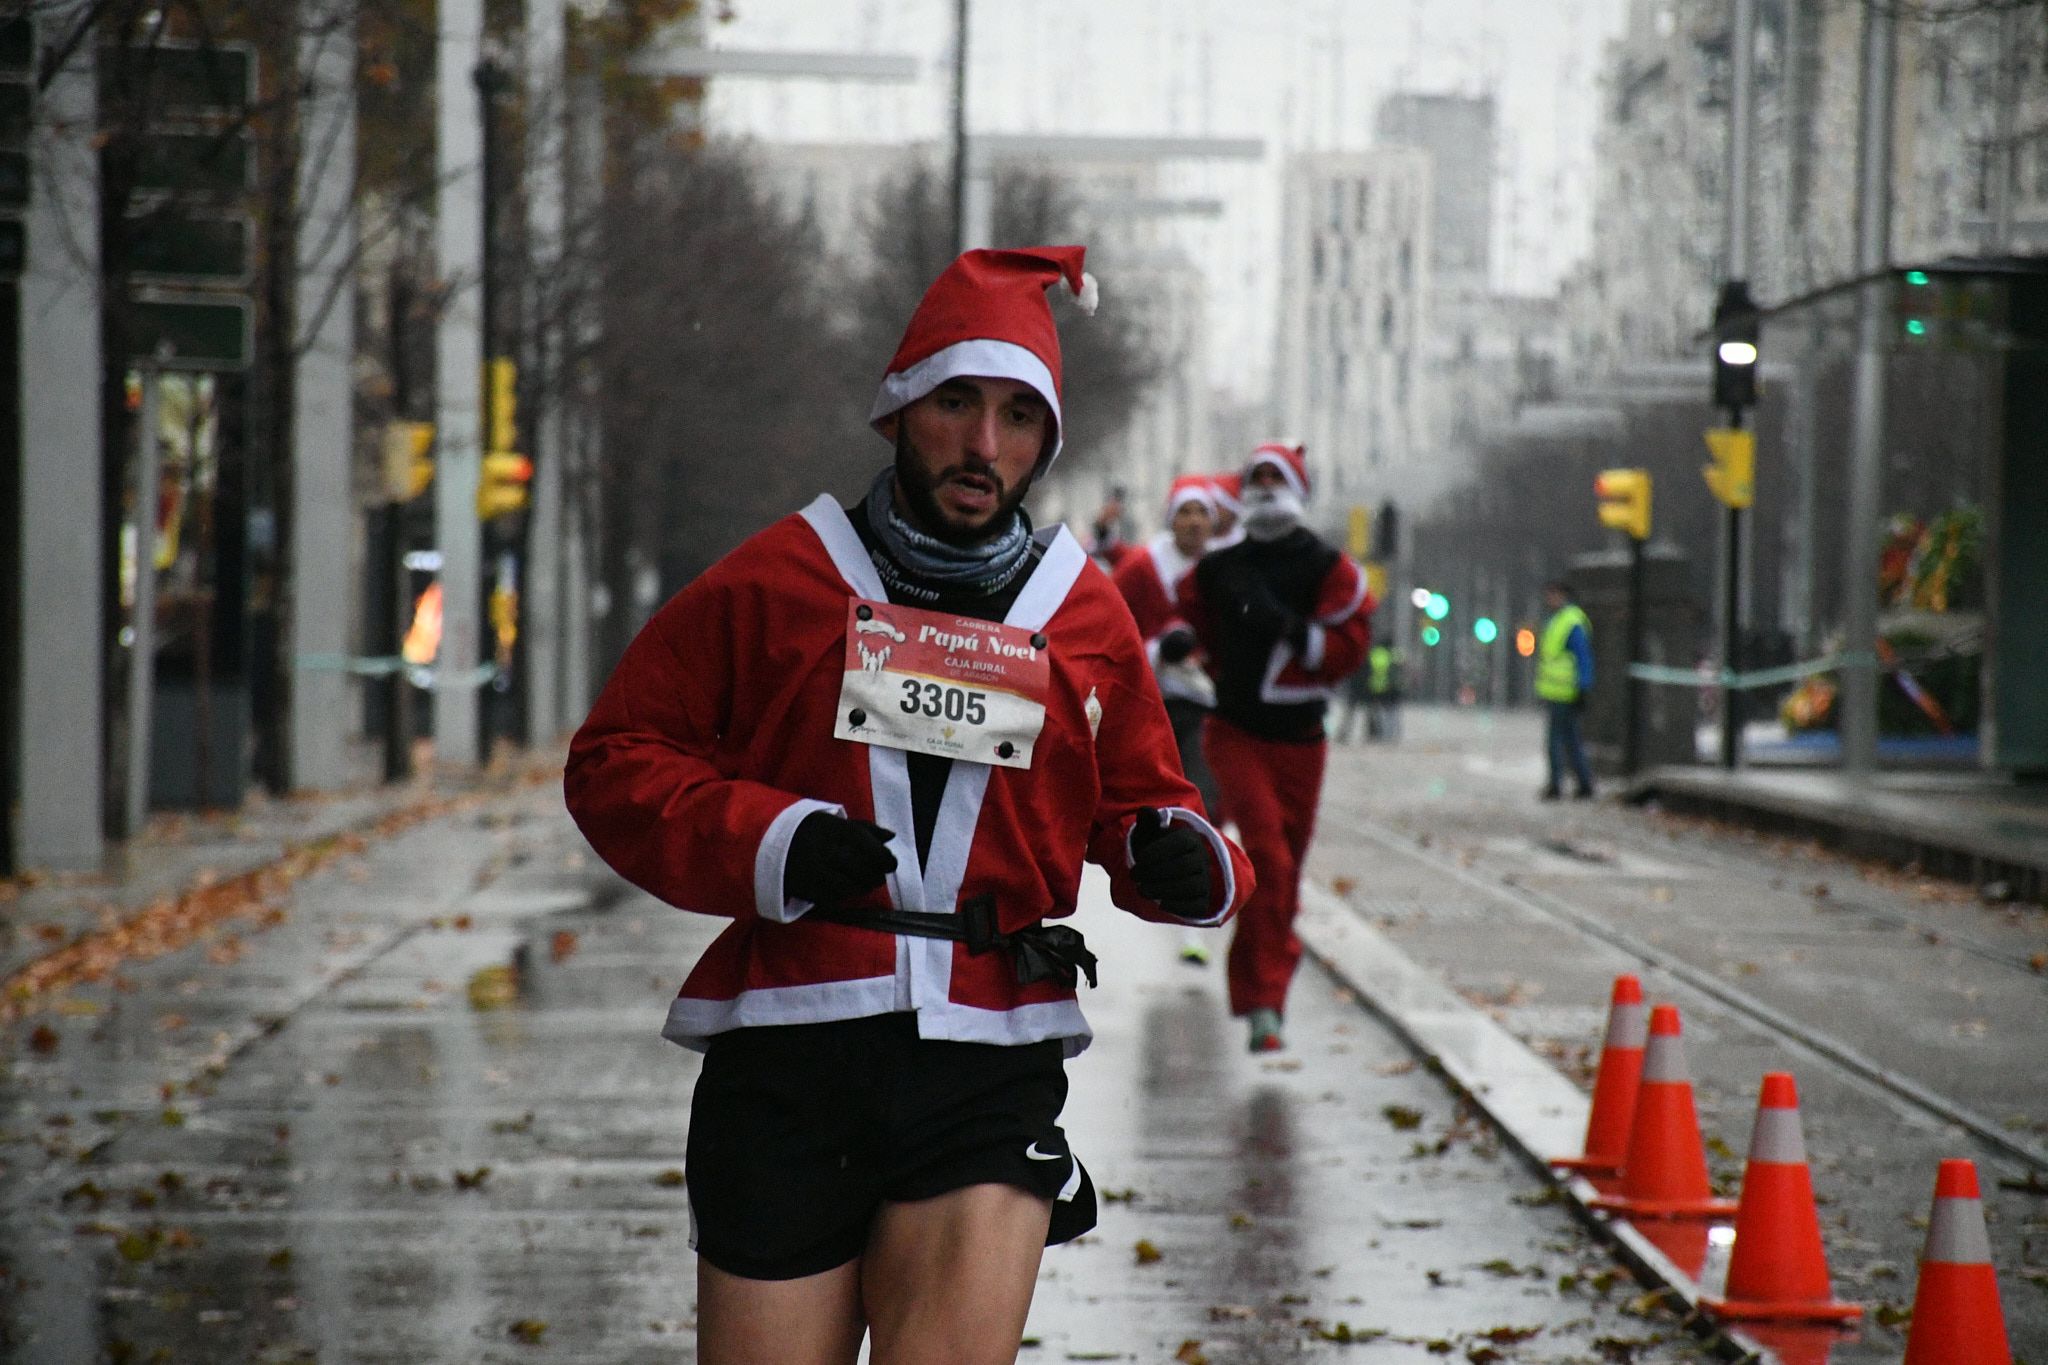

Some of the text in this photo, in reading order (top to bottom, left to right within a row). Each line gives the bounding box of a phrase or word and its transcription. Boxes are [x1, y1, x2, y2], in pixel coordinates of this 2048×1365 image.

[956, 619, 1000, 633] CARRERA
[918, 625, 1036, 662] Papá Noel
[944, 657, 1007, 675] CAJA RURAL
[900, 679, 986, 726] 3305
